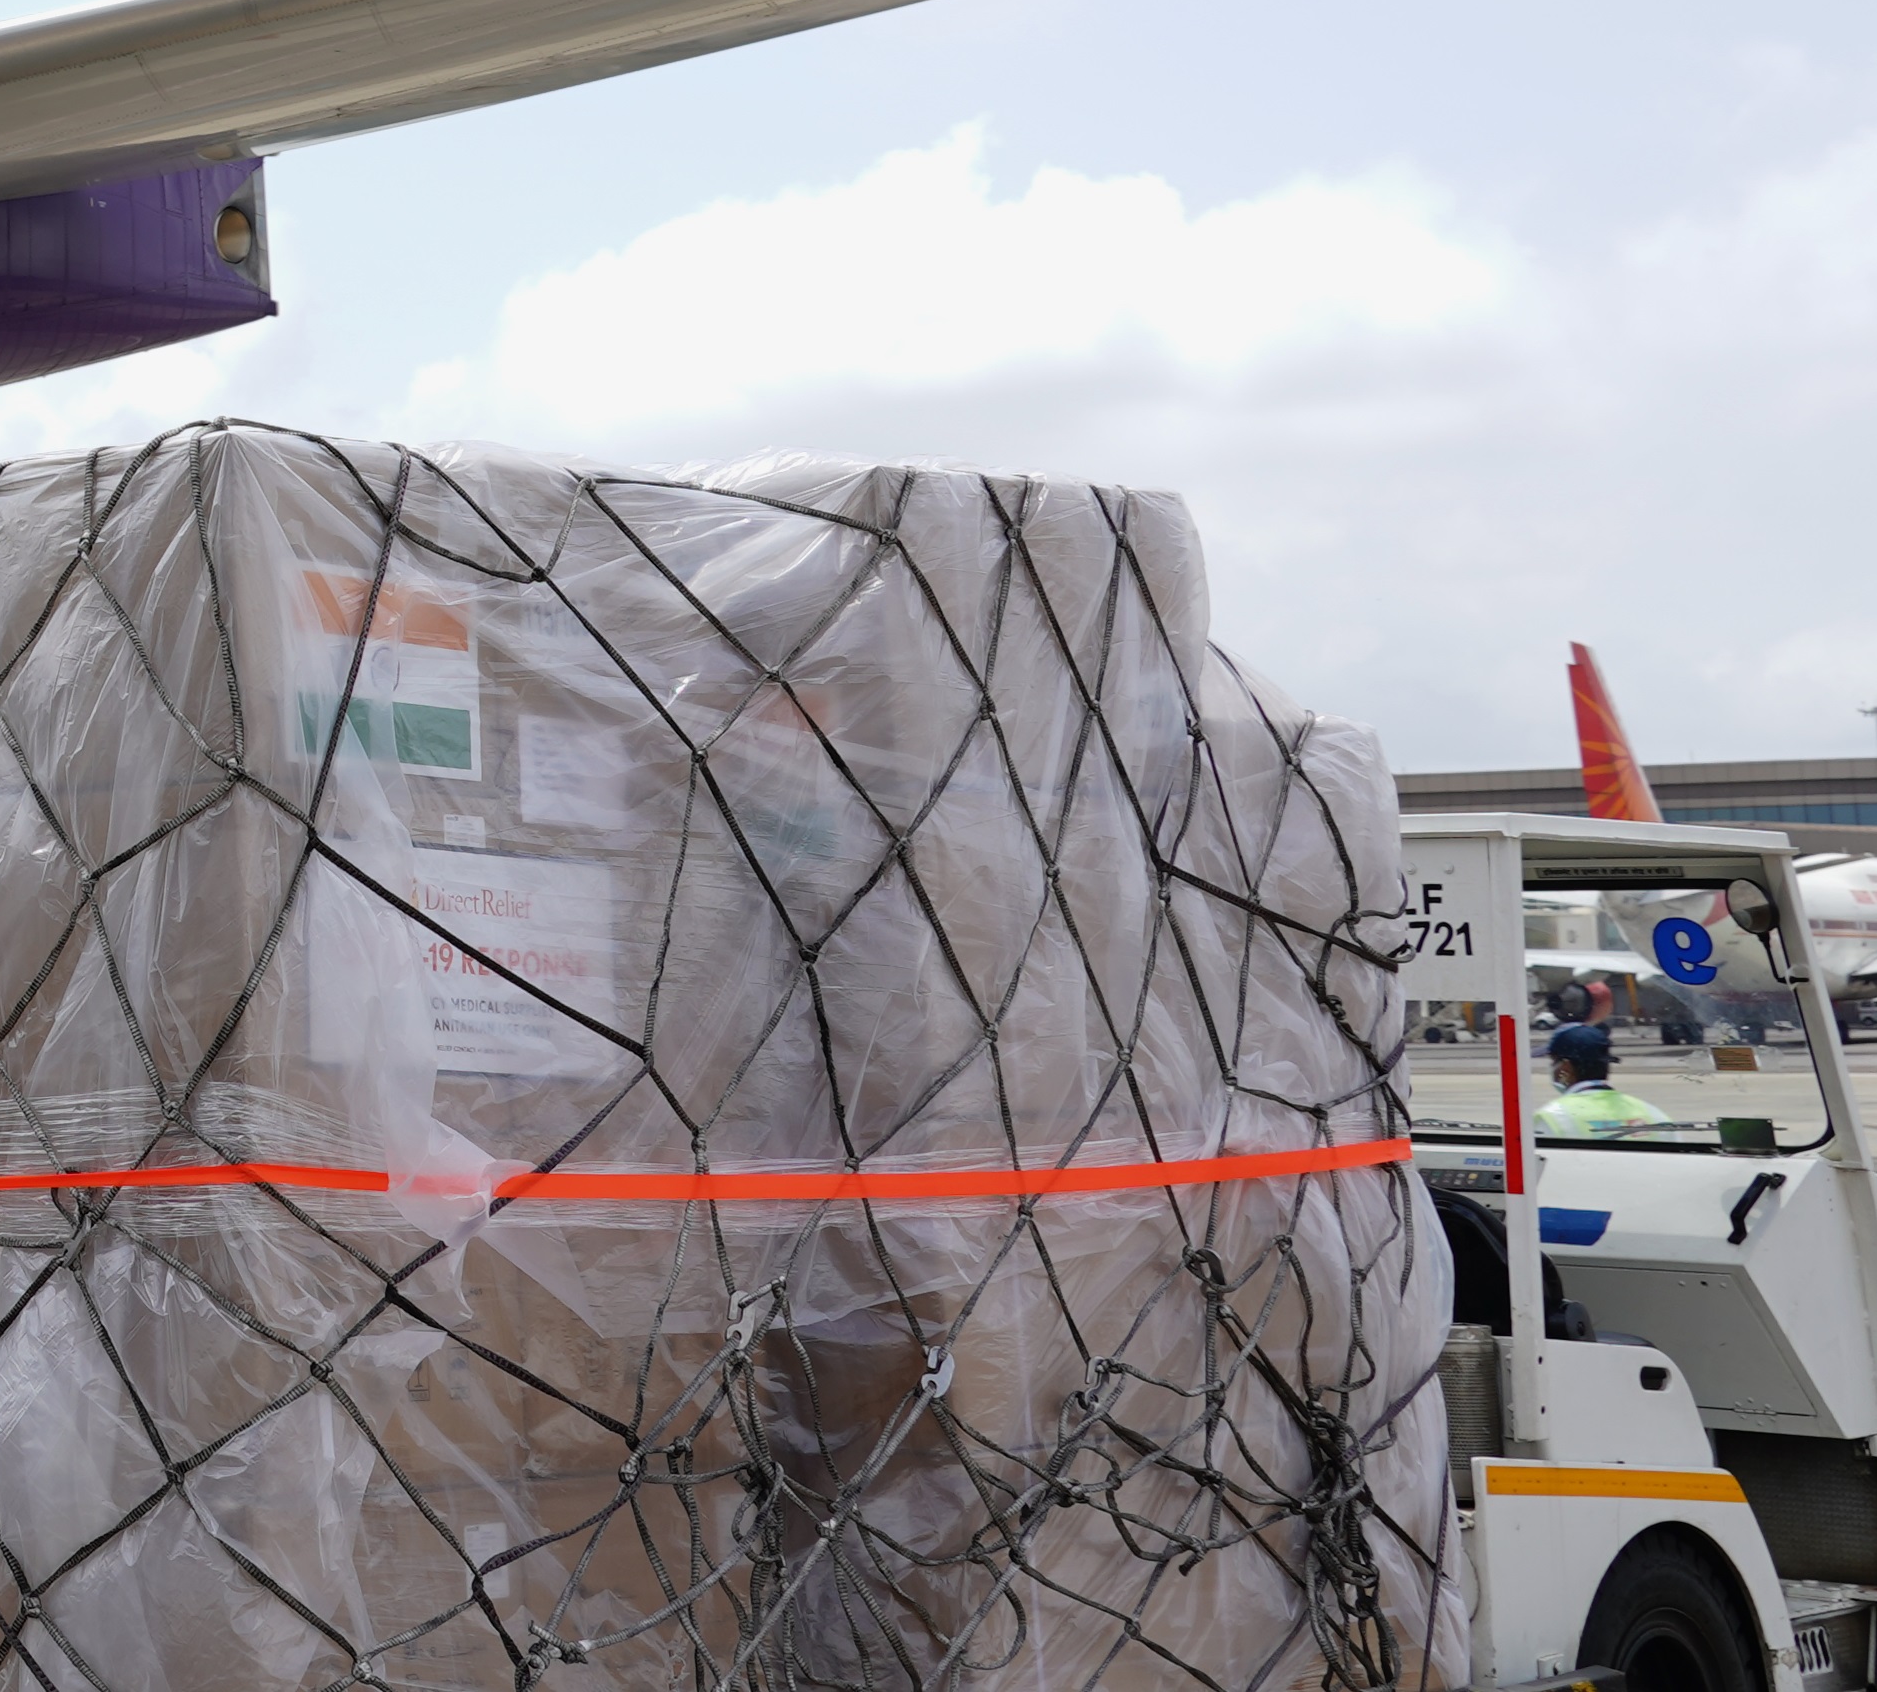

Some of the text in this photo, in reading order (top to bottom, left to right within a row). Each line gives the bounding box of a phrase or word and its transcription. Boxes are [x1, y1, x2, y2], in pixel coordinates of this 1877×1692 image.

[1408, 921, 1473, 956] 721
[461, 946, 590, 977] RESPONSE
[451, 997, 502, 1014] MEDICAL
[434, 1019, 495, 1034] ANITARIAN
